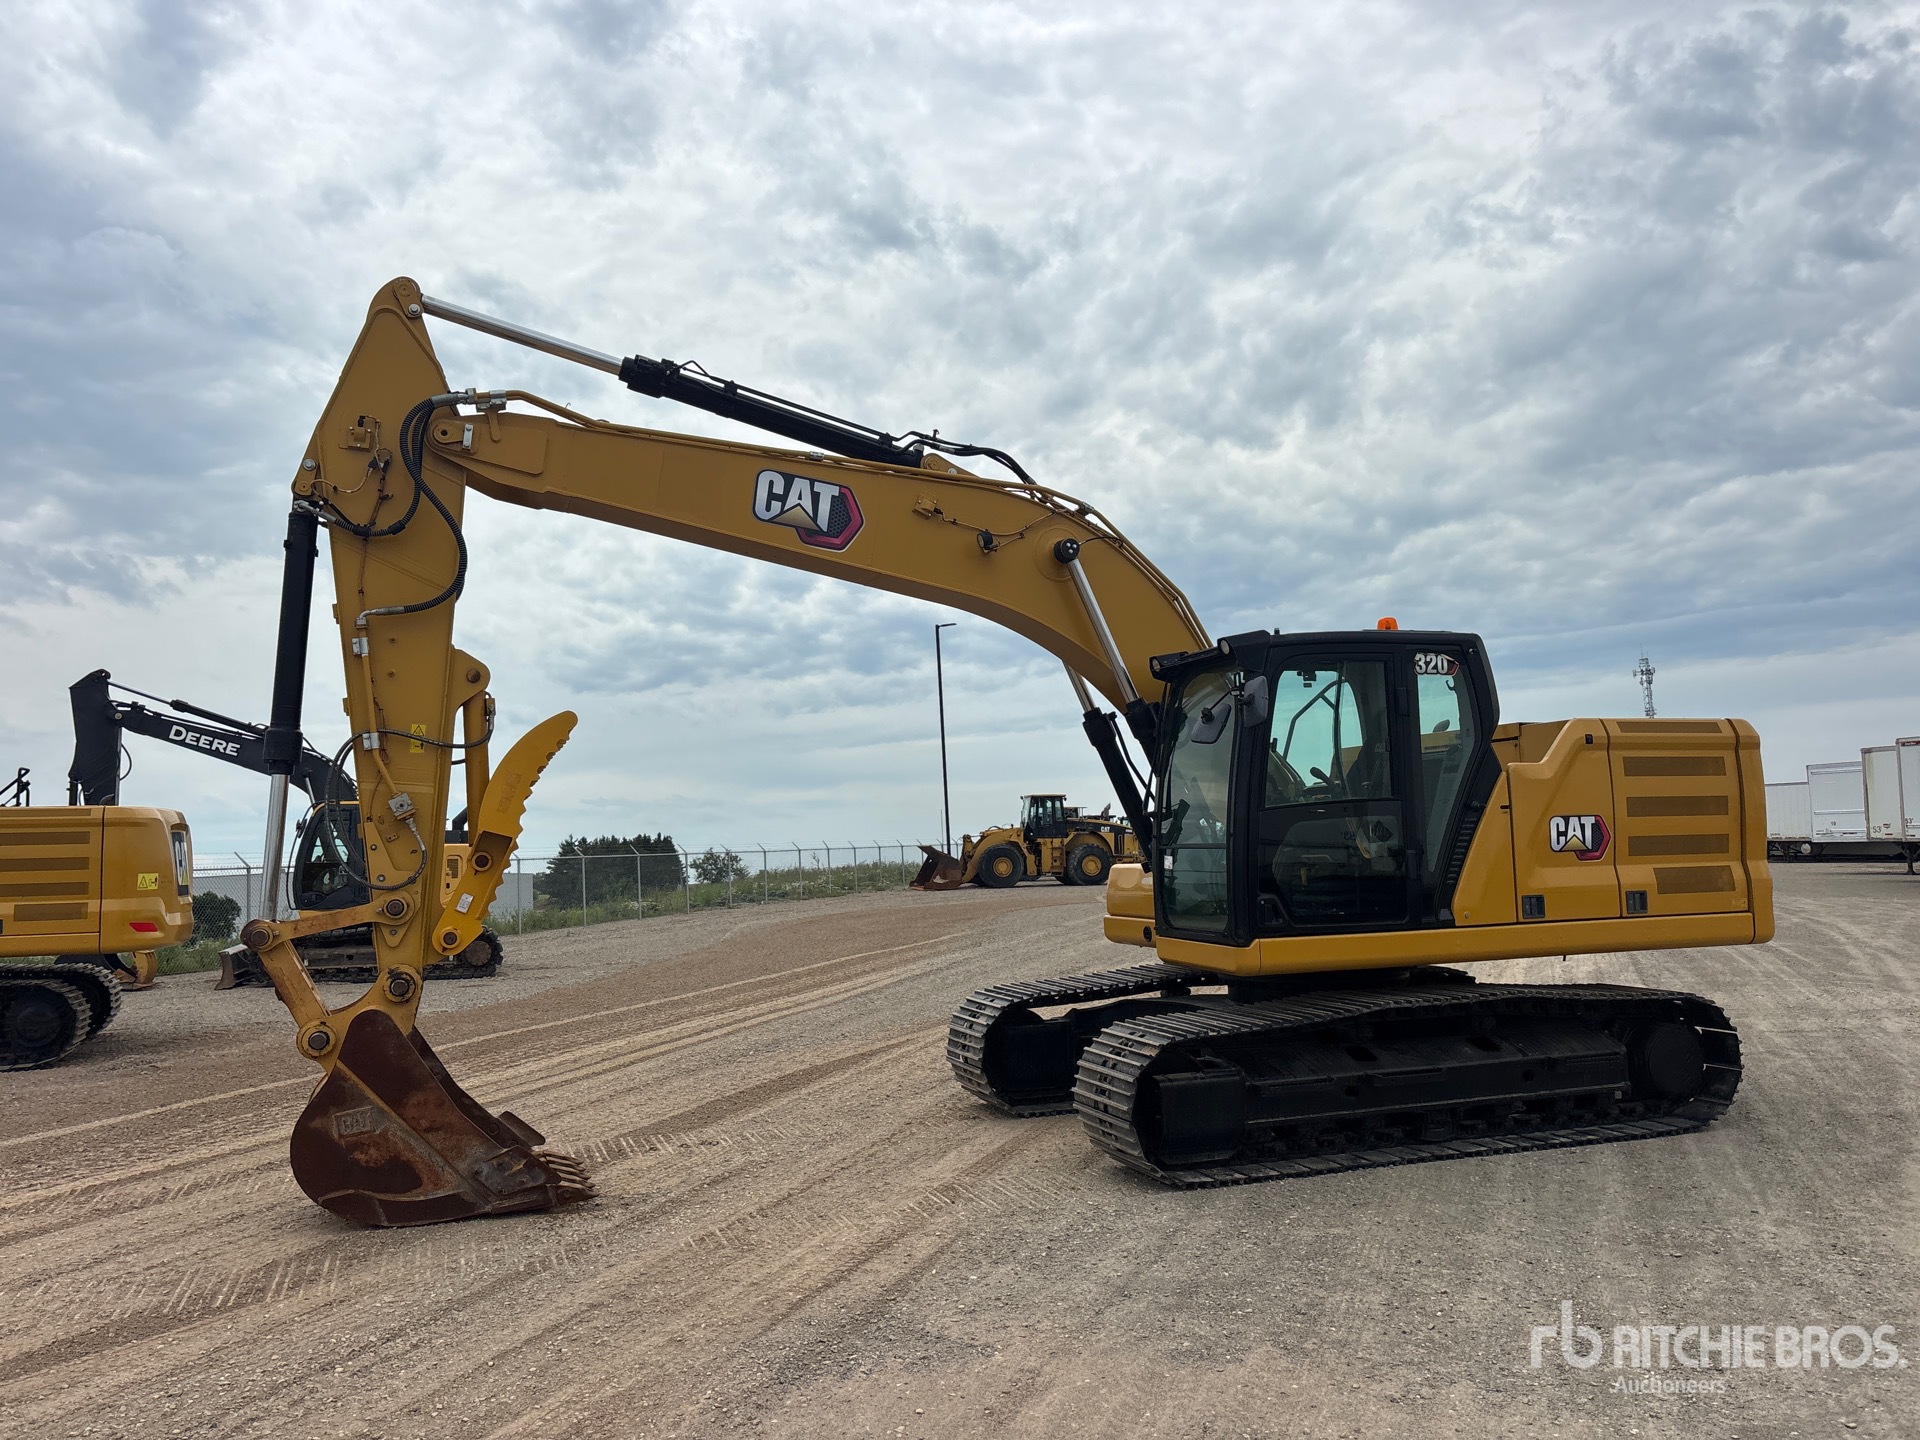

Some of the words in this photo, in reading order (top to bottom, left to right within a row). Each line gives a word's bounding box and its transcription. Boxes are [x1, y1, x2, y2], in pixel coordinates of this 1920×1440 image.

[755, 470, 840, 532] CAT
[1414, 652, 1448, 674] 320
[169, 725, 240, 756] DEERE
[1550, 816, 1595, 851] CAT
[174, 840, 189, 886] CA
